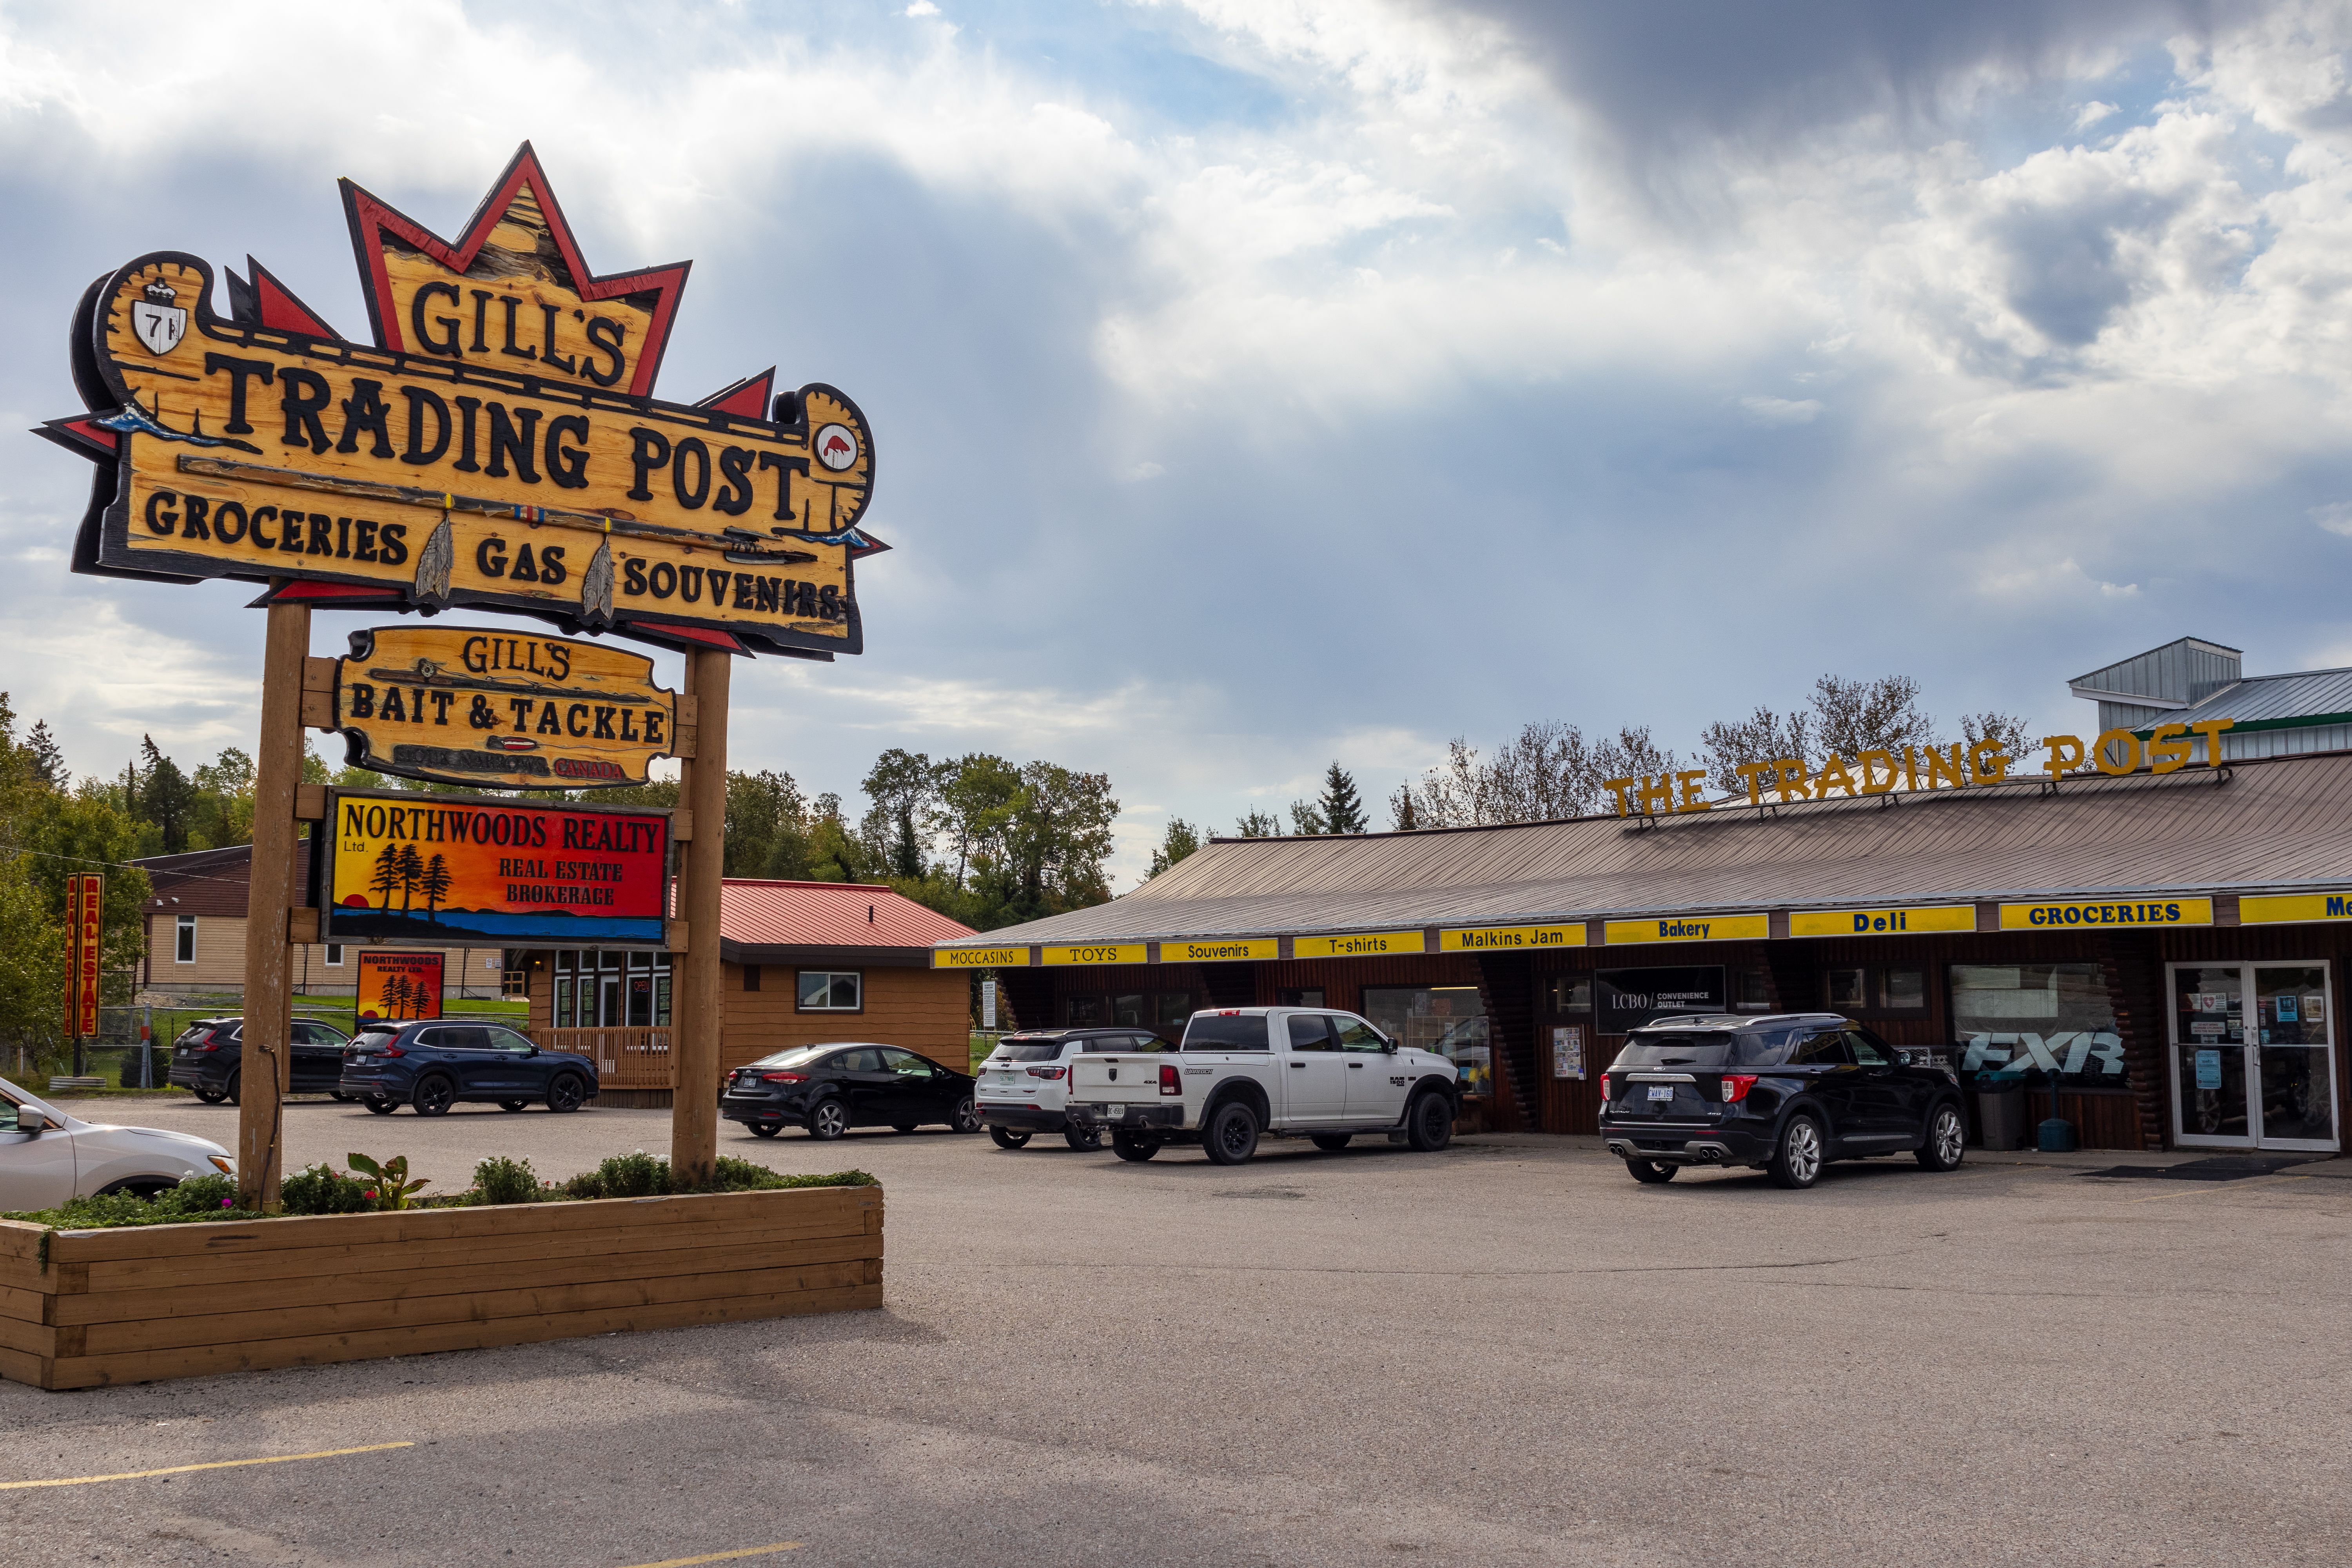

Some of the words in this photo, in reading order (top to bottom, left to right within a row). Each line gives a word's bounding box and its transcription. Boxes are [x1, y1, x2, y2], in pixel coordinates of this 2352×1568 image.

[412, 281, 626, 387] GILL'S
[205, 352, 590, 489] TRADING
[627, 426, 810, 522] POST
[145, 491, 408, 565] GROCERIES
[477, 538, 566, 584] GAS
[624, 557, 840, 620] SOUVENIRS
[463, 635, 571, 681] GILL'S
[350, 683, 455, 725] BAIT
[470, 694, 495, 729] &
[510, 698, 664, 744] TACKLE
[555, 760, 622, 779] CANADA
[1603, 769, 1711, 818] THE
[1735, 738, 2010, 805] TRADING
[2043, 717, 2234, 781] POST
[344, 804, 546, 848] NORTHWOODS
[563, 818, 660, 853] REALTY
[344, 840, 369, 853] Ltd.
[499, 858, 548, 878] REAL
[555, 861, 622, 882] ESTATE
[506, 884, 614, 906] BROKERAGE
[85, 879, 98, 939] REAL
[2029, 904, 2180, 925] GROCERIES
[1659, 920, 1710, 939] Bakery
[1854, 912, 1906, 932] Deli
[1329, 939, 1387, 953] T-shirts
[1462, 931, 1522, 947] Malkins
[1530, 929, 1563, 944] Jam
[363, 955, 439, 965] NORTHWOODS
[950, 951, 1013, 964] MOCCASINS
[1070, 947, 1117, 962] TOYS
[1188, 944, 1249, 958] Souvenirs
[82, 946, 96, 1033] ESTATE
[1613, 993, 1646, 1009] LCBO
[1960, 1031, 2125, 1074] FXR
